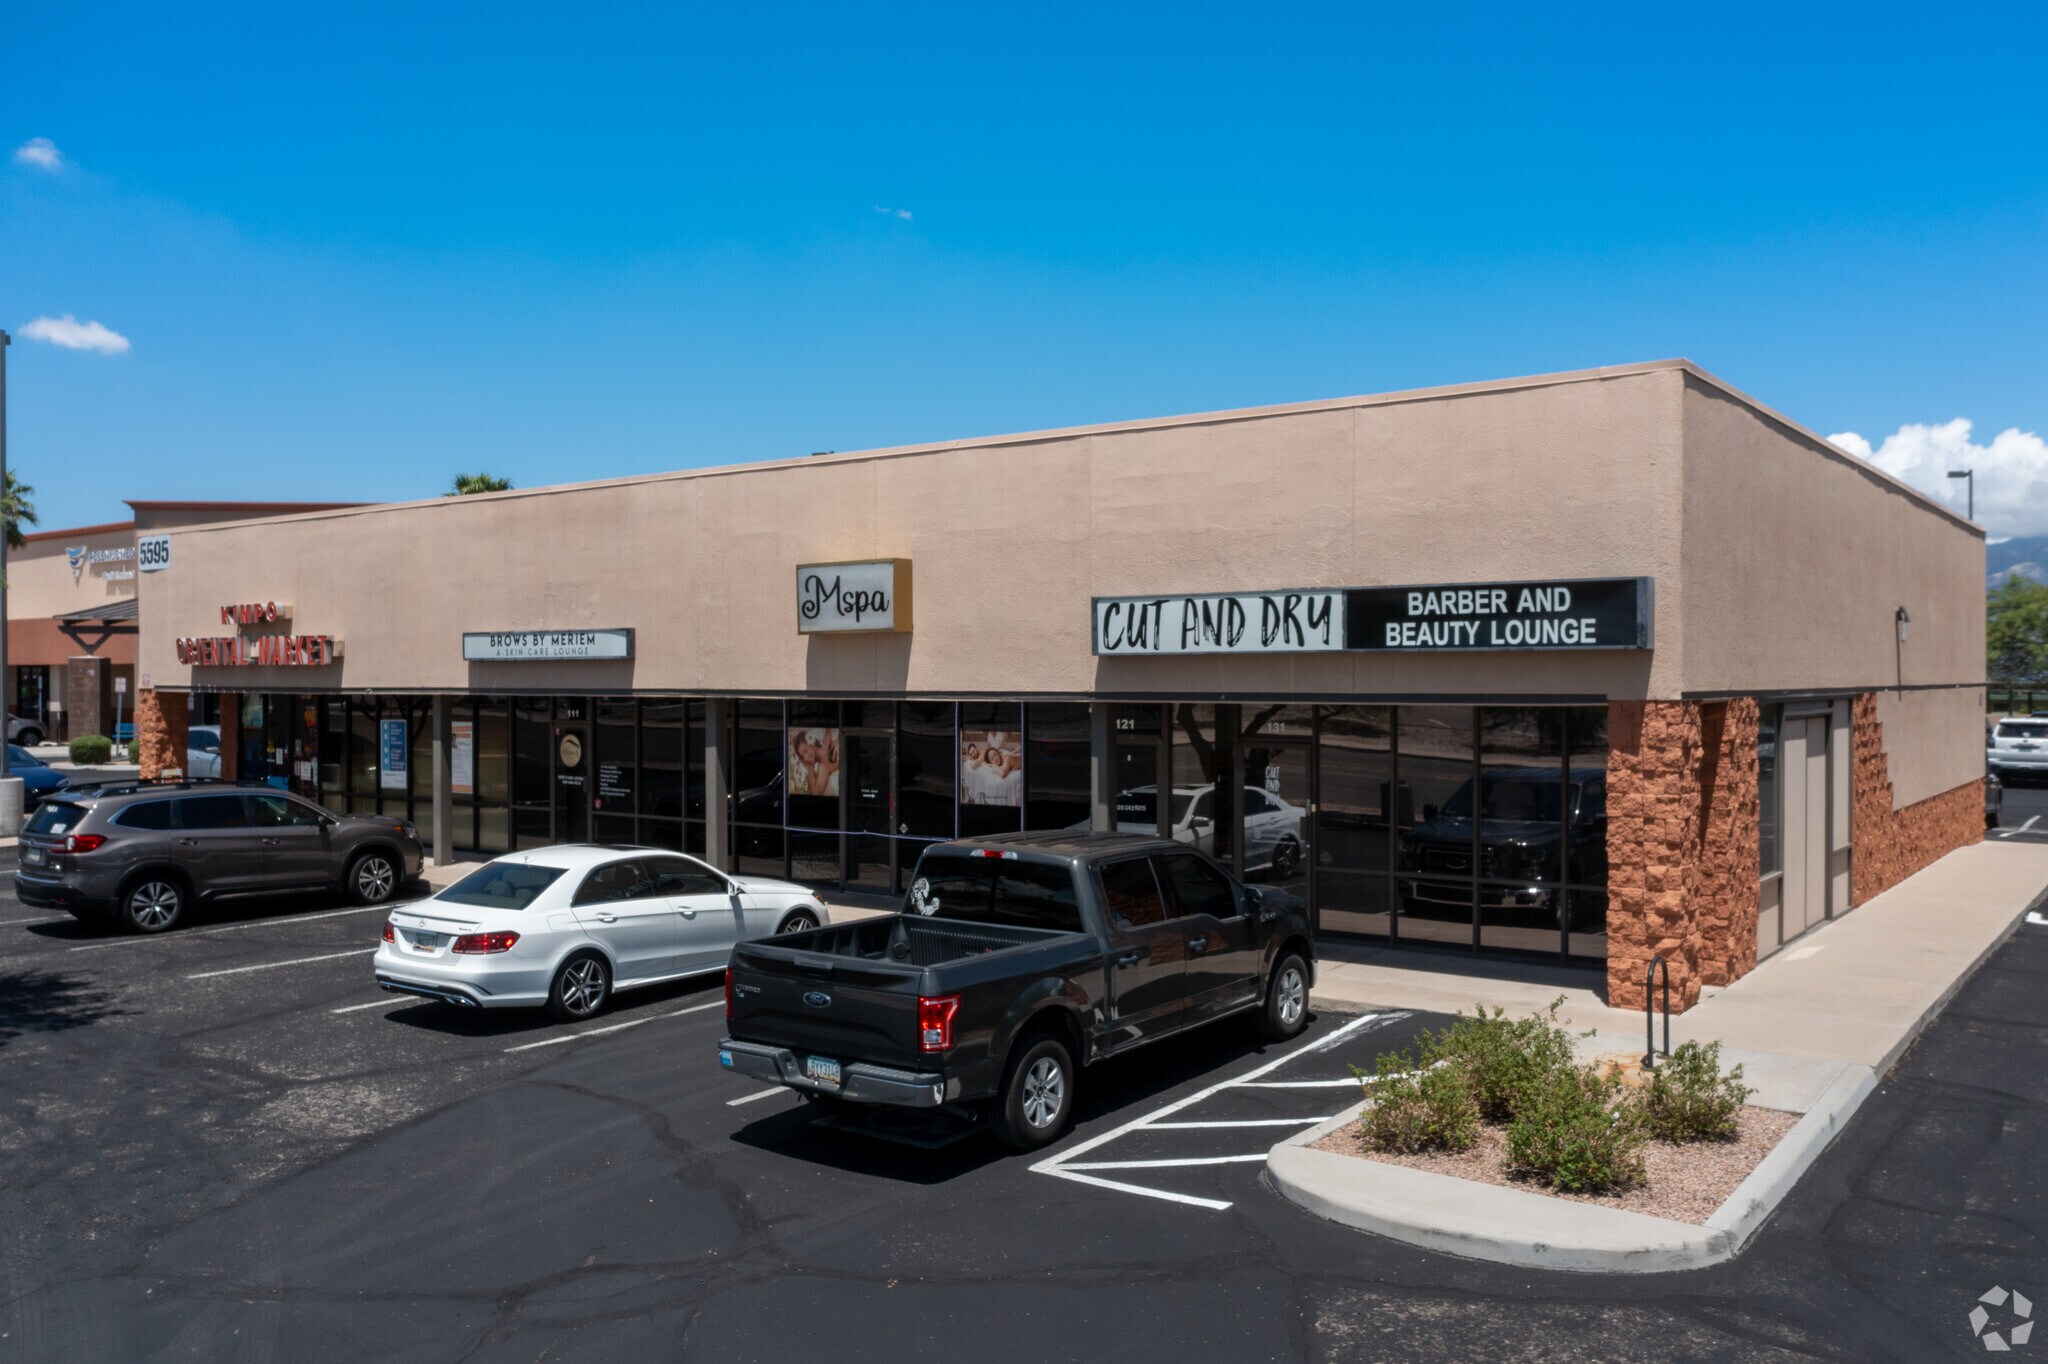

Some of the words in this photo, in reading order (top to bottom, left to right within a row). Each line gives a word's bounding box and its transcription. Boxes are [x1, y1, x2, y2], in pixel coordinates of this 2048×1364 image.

[140, 540, 169, 565] 5595
[801, 574, 890, 623] Mspa
[1407, 588, 1508, 616] BARBER
[1516, 586, 1571, 613] AND
[221, 601, 278, 625] KIMPO
[1103, 600, 1170, 651] CUT
[1181, 597, 1246, 650] AND
[1259, 594, 1333, 648] DRY
[490, 634, 528, 648] BROWS
[533, 634, 546, 647] BY
[551, 632, 596, 646] MERIEM
[1385, 620, 1480, 647] BEAUTY
[1490, 618, 1596, 645] LOUNGE
[176, 636, 250, 666] ORIENTAL
[257, 635, 329, 666] MARKET
[528, 648, 549, 656] CARE
[553, 647, 590, 656] LOUNGE
[567, 709, 579, 718] 111
[1115, 719, 1135, 730] 121
[1267, 722, 1285, 732] 131
